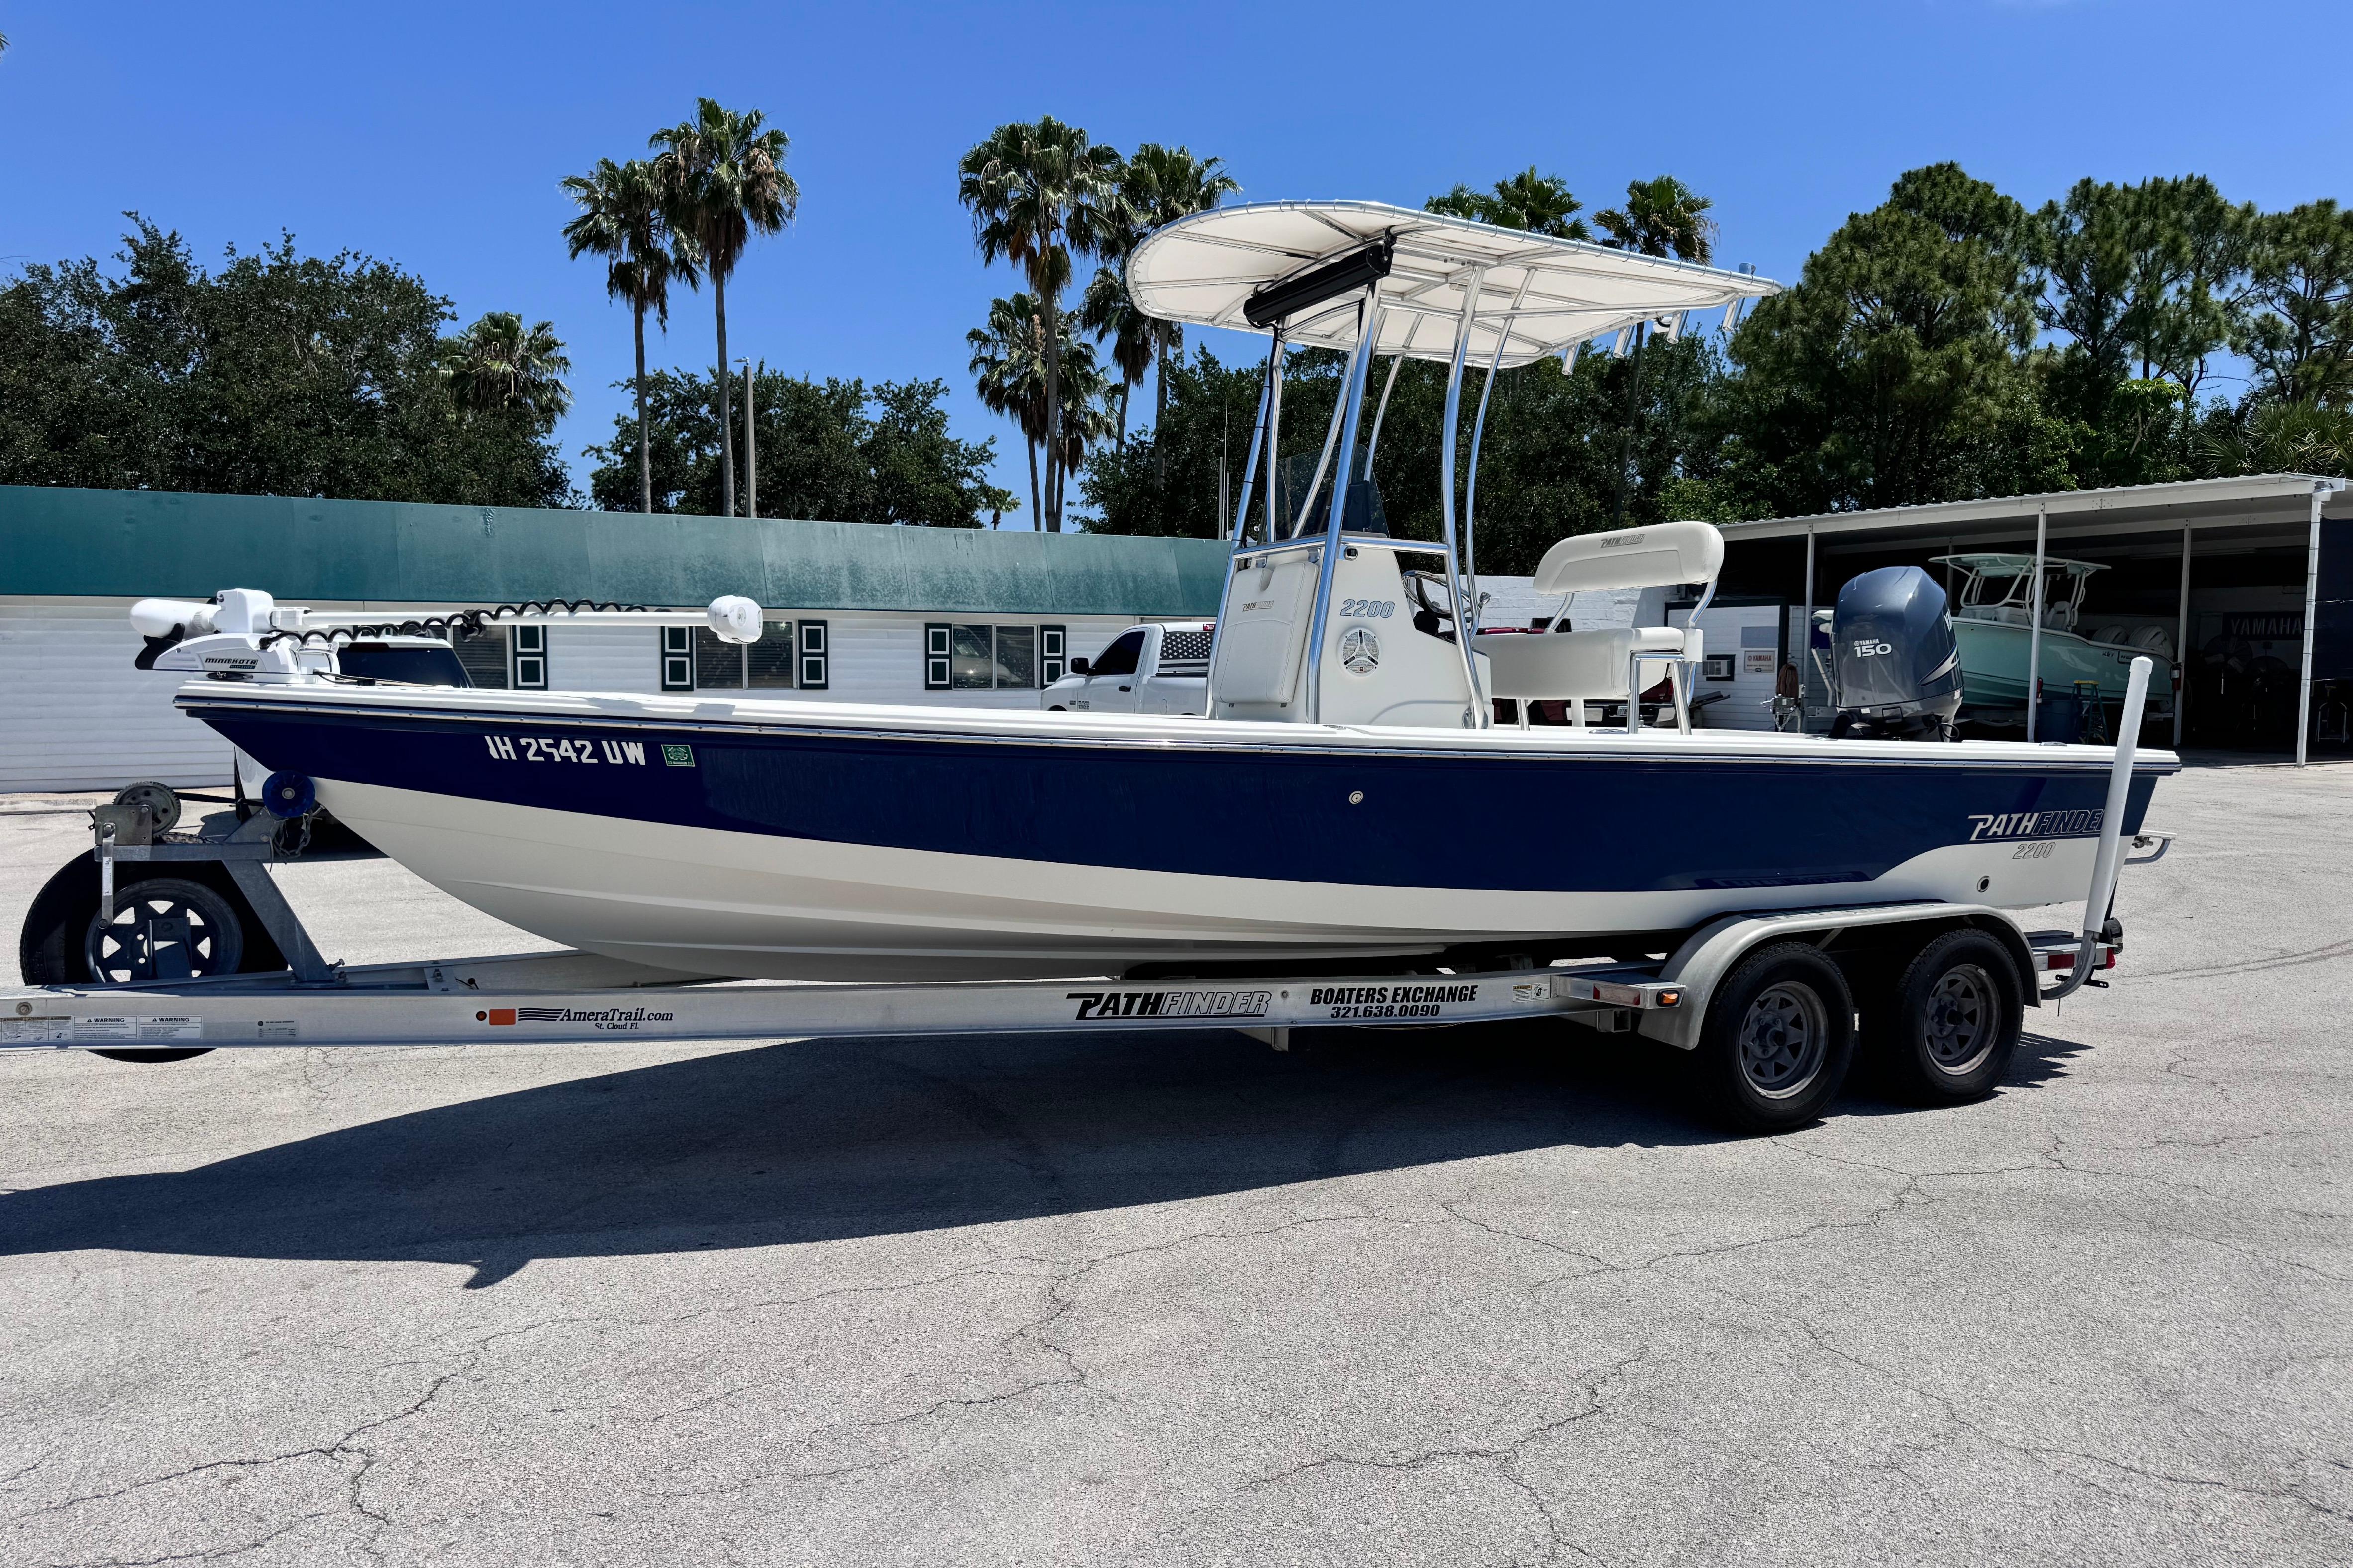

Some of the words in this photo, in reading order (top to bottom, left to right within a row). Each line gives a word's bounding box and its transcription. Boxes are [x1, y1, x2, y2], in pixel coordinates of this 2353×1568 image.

[1339, 599, 1395, 618] 2200
[2230, 617, 2303, 635] YAMAHA
[1854, 643, 1892, 658] 150
[519, 738, 599, 763] 2542
[601, 741, 646, 765] UW
[2012, 842, 2056, 859] 2200
[1310, 987, 1388, 1005] BOATERS
[1391, 985, 1478, 1003] EXCHANGE
[560, 1007, 673, 1021] AmeraTrail.com
[1066, 991, 1272, 1020] PATHFINDER
[1330, 1004, 1440, 1018] 321.638.0090
